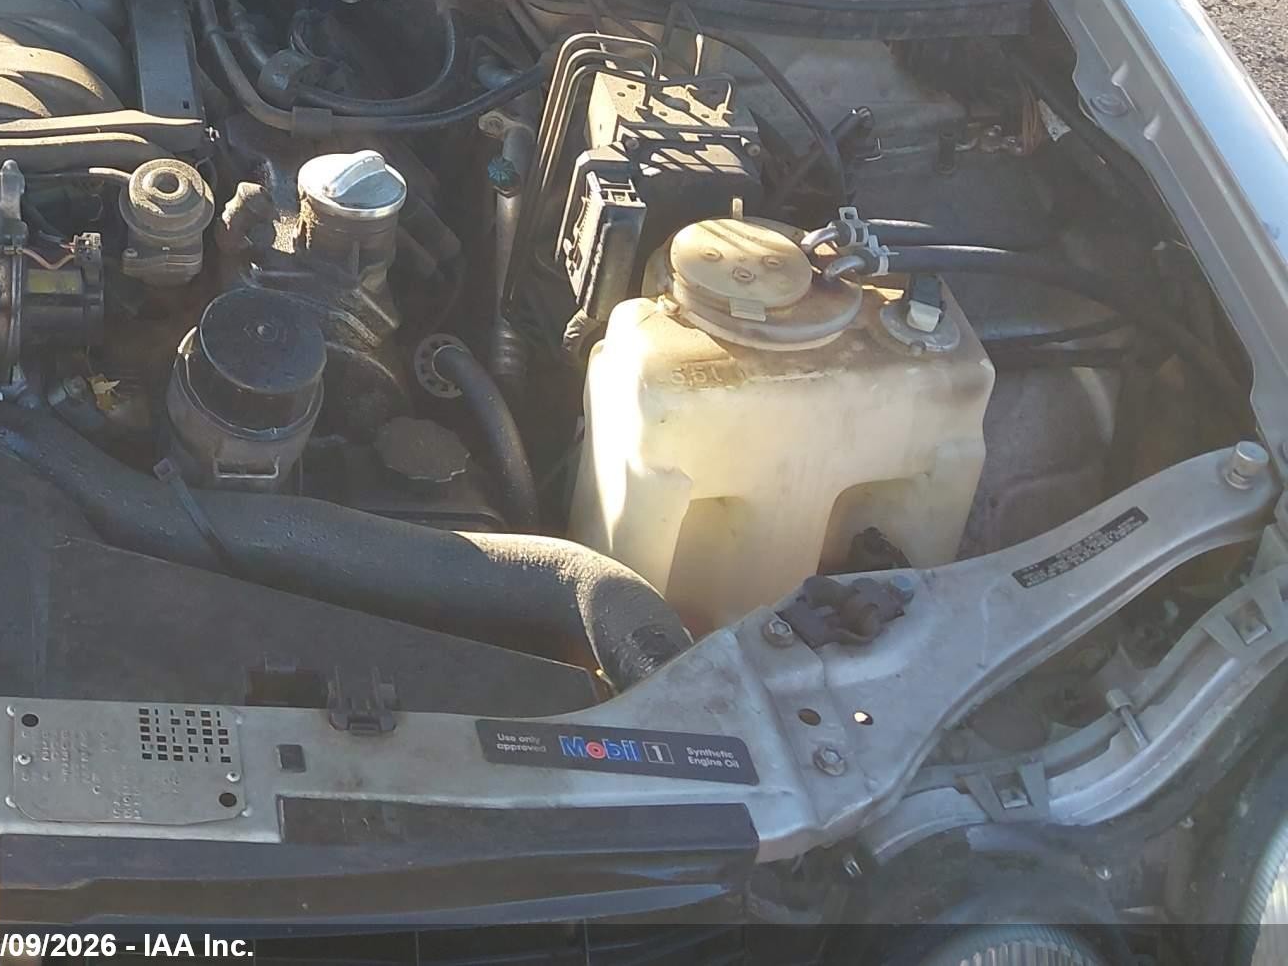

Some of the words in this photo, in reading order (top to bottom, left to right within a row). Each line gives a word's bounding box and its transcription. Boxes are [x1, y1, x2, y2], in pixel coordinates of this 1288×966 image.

[496, 732, 517, 743] Use
[496, 743, 547, 753] approved
[558, 733, 642, 762] Mobil
[686, 746, 734, 759] Synthetic
[687, 756, 723, 767] Engine
[724, 758, 740, 769] Oil
